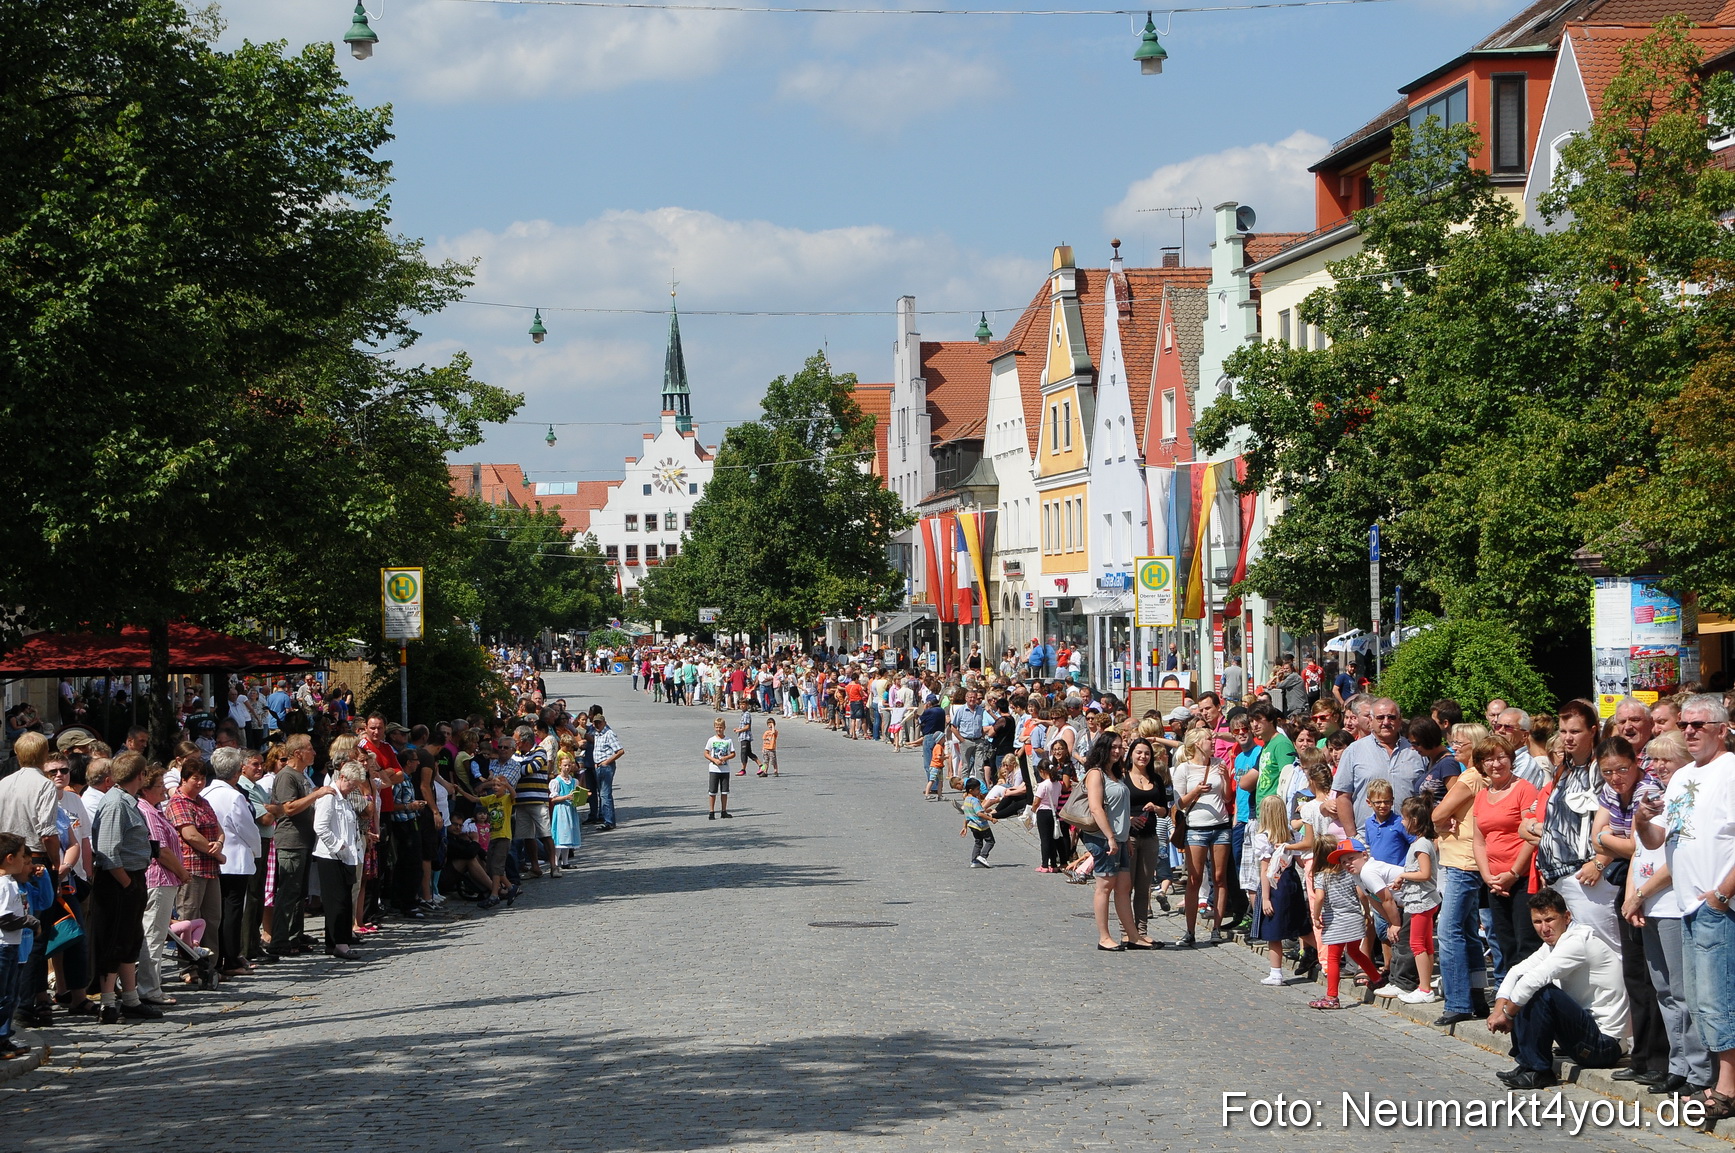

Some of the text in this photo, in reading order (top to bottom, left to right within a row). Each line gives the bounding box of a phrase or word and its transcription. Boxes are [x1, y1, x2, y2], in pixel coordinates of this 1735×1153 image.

[1371, 530, 1377, 557] P
[1147, 567, 1162, 584] H
[395, 579, 410, 597] H
